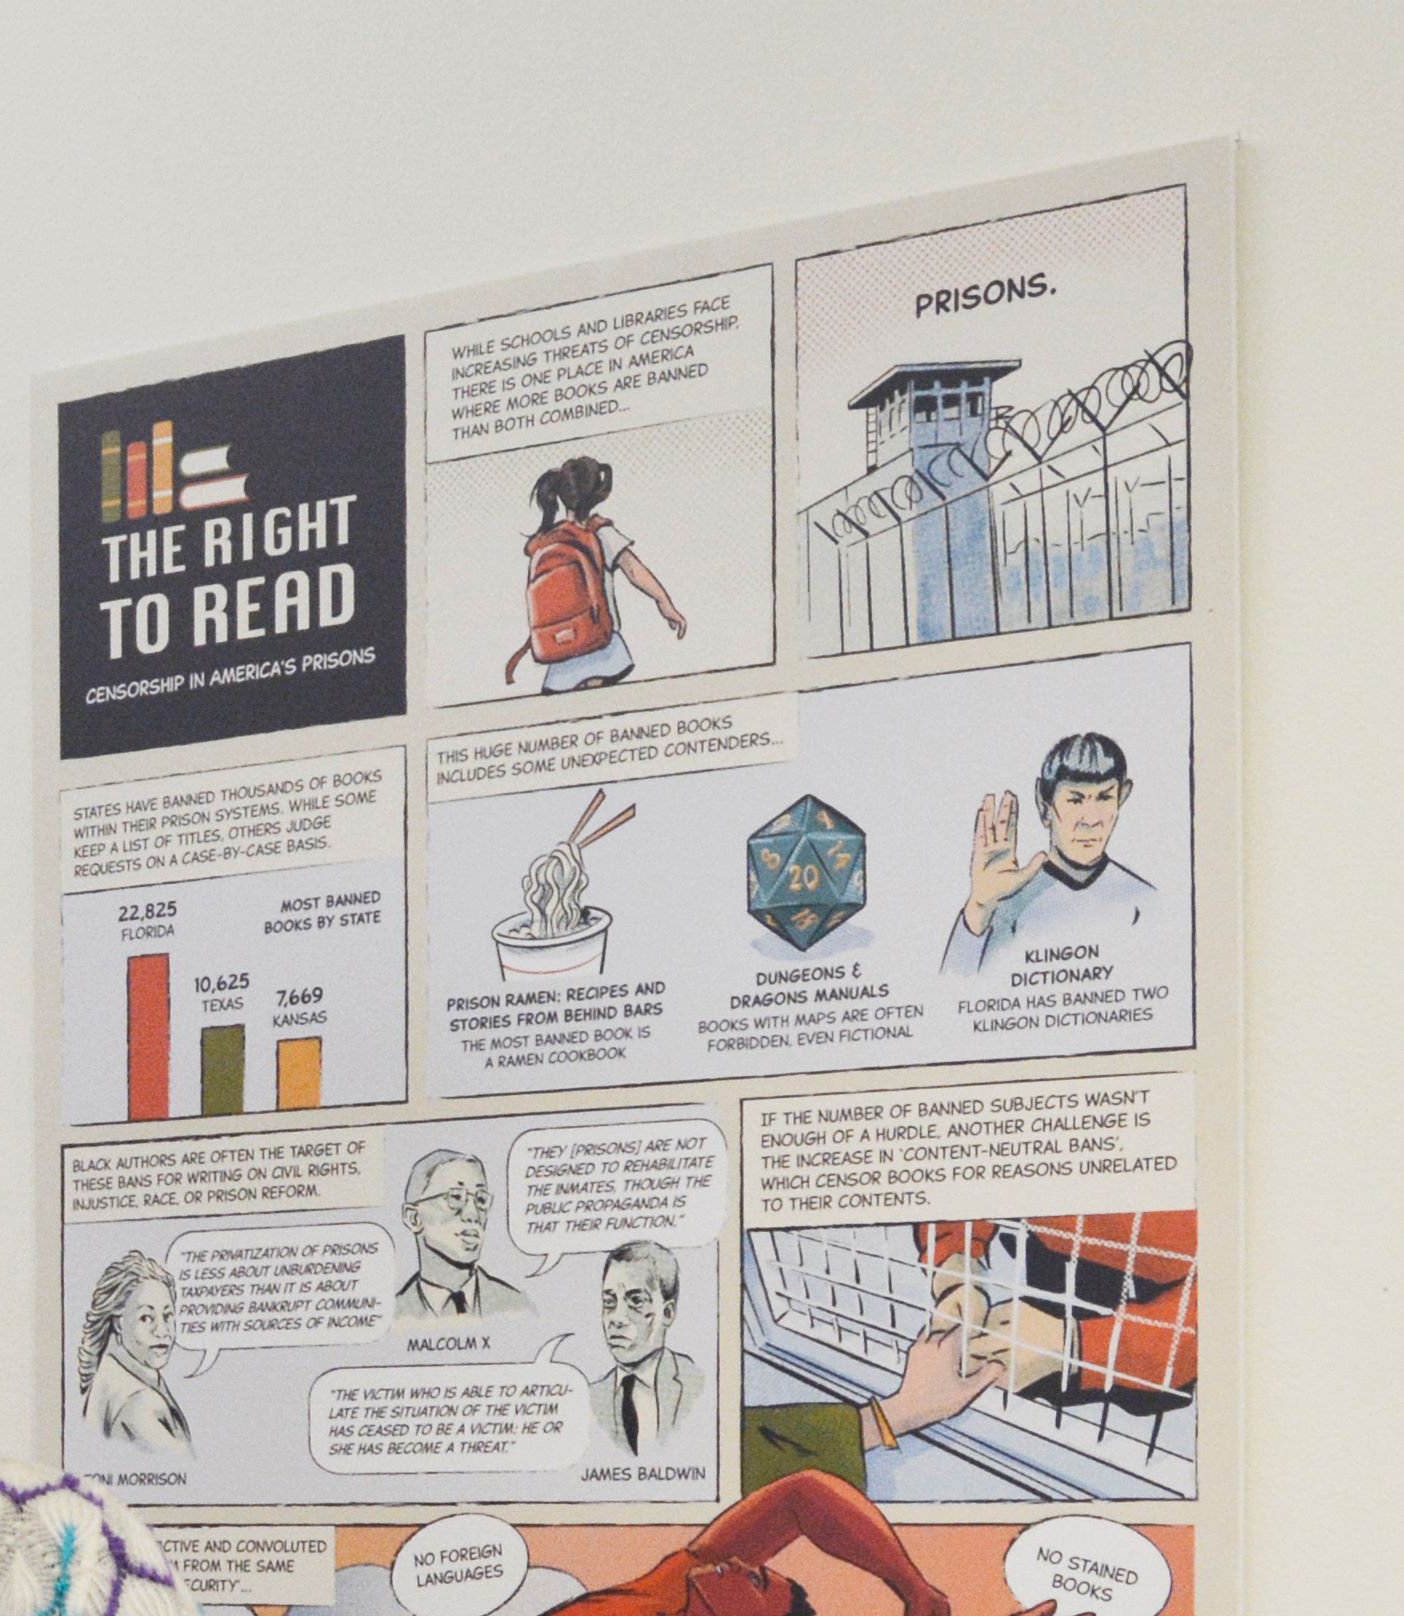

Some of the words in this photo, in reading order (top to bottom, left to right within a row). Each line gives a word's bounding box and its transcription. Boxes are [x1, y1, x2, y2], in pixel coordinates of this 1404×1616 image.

[915, 271, 1057, 319] PRISONS.
[450, 338, 495, 360] WHILE
[499, 324, 572, 352] SCHOOLS
[576, 318, 608, 338] AND
[612, 302, 689, 331] LIBRARIES
[692, 294, 731, 315] FACE
[451, 351, 538, 381] INCREASING
[542, 338, 609, 363] THREATS
[613, 333, 634, 351] OF
[451, 378, 497, 400] THERE
[501, 375, 516, 392] IS
[520, 368, 552, 389] ONE
[556, 359, 604, 382] PLACE
[608, 357, 623, 373] IN
[627, 343, 695, 369] AMERICA
[450, 398, 501, 421] WHERE
[505, 389, 549, 411] MORE
[553, 379, 609, 403] BOOKS
[612, 372, 642, 392] ARE
[646, 361, 709, 387] BANNED
[451, 422, 490, 441] THAN
[493, 413, 535, 434] BOTH
[538, 398, 630, 426] COMBINED...
[100, 523, 186, 584] THE
[203, 493, 358, 568] RIGHT
[99, 592, 170, 660] TO
[192, 562, 355, 647] READ
[84, 674, 185, 705] CENSORSHIP
[188, 671, 206, 690] IN
[208, 657, 297, 687] AMERICA'S
[301, 645, 376, 672] PRISONS
[787, 864, 821, 893] 20
[117, 899, 177, 923] 22,825
[279, 895, 321, 913] MOST
[325, 889, 381, 909] BANNED
[120, 923, 175, 942] FLORIDA
[263, 916, 313, 935] BOOKS
[316, 914, 336, 930] BY
[338, 909, 381, 927] STATE
[1024, 943, 1099, 964] KLINGON
[193, 971, 250, 995] 10,625
[755, 964, 846, 987] DUNGEONS
[1010, 964, 1114, 988] DICTIONARY
[201, 995, 244, 1013] TEXAS
[275, 985, 324, 1009] 7,669
[446, 994, 501, 1012] PRISON
[504, 989, 561, 1007] RAMEN:
[565, 983, 629, 1002] RECIPES
[634, 980, 666, 996] AND
[729, 989, 809, 1010] DRAGONS
[813, 982, 890, 1003] MANUALS
[272, 1009, 328, 1028] KANSAS
[449, 1013, 512, 1033] STORIES
[516, 1010, 559, 1027] FROM
[563, 1004, 618, 1024] BEHIND
[623, 1001, 663, 1019] BARS
[406, 1335, 478, 1352] MALCOLM
[481, 1335, 491, 1350] X
[116, 1471, 187, 1486] MORRISON
[580, 1466, 632, 1482] JAMES
[636, 1465, 706, 1482] BALDWIN
[413, 1551, 436, 1568] NO
[439, 1543, 503, 1564] FOREIGN
[1036, 1545, 1063, 1565] NO
[1067, 1555, 1139, 1587] STAINED
[415, 1563, 504, 1589] LANGUAGES
[1051, 1572, 1113, 1603] BOOKS
